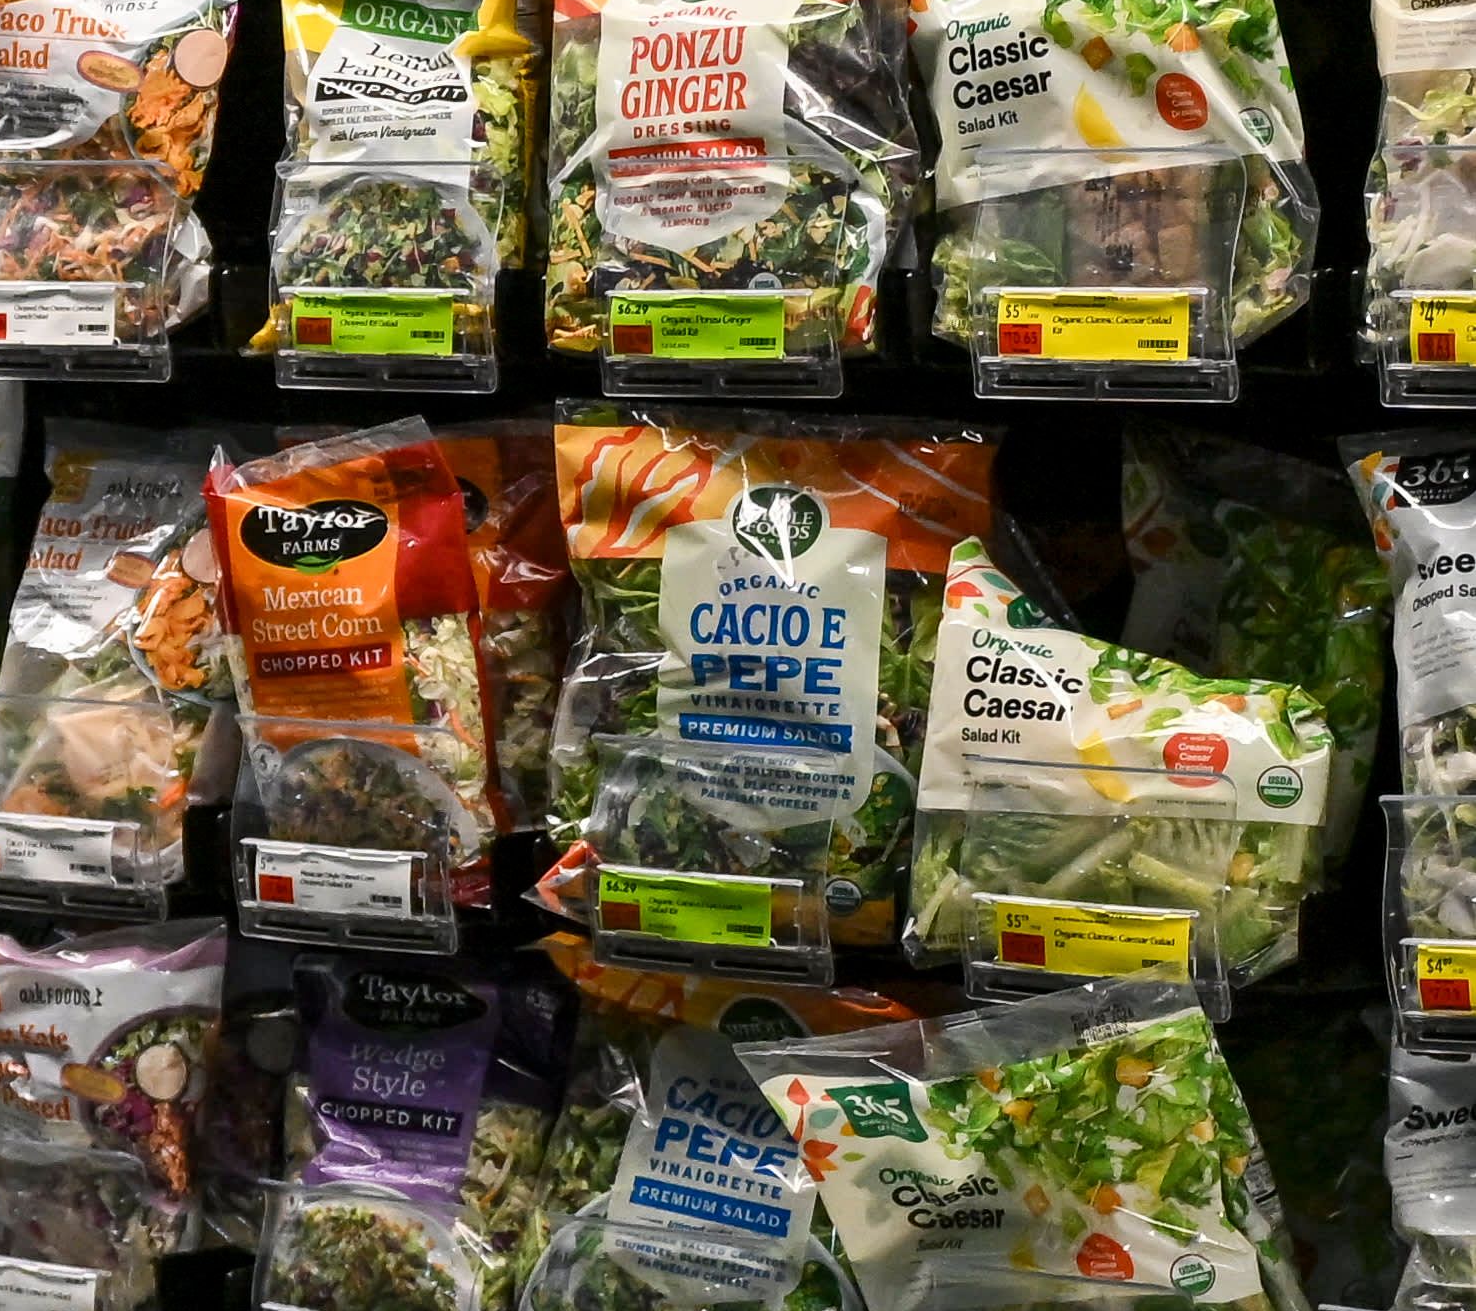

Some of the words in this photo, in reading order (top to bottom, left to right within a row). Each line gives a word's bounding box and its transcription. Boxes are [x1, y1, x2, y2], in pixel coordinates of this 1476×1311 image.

[647, 5, 738, 28] ORGANIC
[945, 12, 1012, 44] Organic
[629, 28, 745, 74] PONZU
[947, 34, 1050, 76] Classic
[323, 81, 422, 104] CHOPPED
[427, 88, 464, 99] KIT
[620, 73, 748, 120] GINGER
[952, 68, 1052, 109] Caesar
[379, 125, 437, 141] Vinaigrette
[632, 118, 731, 138] DRESSING
[957, 112, 995, 135] Salad
[997, 109, 1019, 128] Kit
[696, 144, 758, 159] SALAD
[661, 218, 710, 228] ALMONDS
[617, 303, 649, 316] $6.29
[257, 502, 384, 535] Taylor
[281, 538, 341, 555] FARMS
[262, 580, 364, 611] Mexican
[717, 575, 821, 602] ORGANIC
[252, 614, 319, 642] Street
[321, 612, 383, 638] Corn
[689, 605, 814, 647] CACIO
[822, 608, 847, 645] E
[971, 626, 1054, 660] Organic
[260, 650, 343, 673] CHOPPED
[349, 647, 384, 667] KIT
[693, 654, 843, 696] PEPE
[966, 655, 1085, 696] Classic
[690, 693, 842, 718] VINAIGRETTE
[963, 687, 1074, 723] Caesar
[688, 720, 771, 739] PREMIUM
[776, 727, 843, 746] SALAD
[961, 727, 999, 745] Salad
[1002, 727, 1021, 745] Kit
[796, 771, 855, 786] CROUTON
[1268, 775, 1293, 786] USDA
[768, 794, 818, 811] CHEESE
[358, 972, 469, 1009] Taylor
[350, 1042, 447, 1071] Wedge
[352, 1066, 426, 1099] Style
[321, 1101, 411, 1127] CHOPPED
[421, 1105, 456, 1132] KIT
[845, 1094, 905, 1125] 365
[653, 1115, 801, 1179] PEPE
[648, 1157, 784, 1201] VINAIGRETTE
[878, 1166, 954, 1190] Organic
[890, 1174, 999, 1210] Classic
[639, 1184, 719, 1217] PREMIUM
[721, 1201, 781, 1229] SALAD
[907, 1206, 1005, 1230] Caesar
